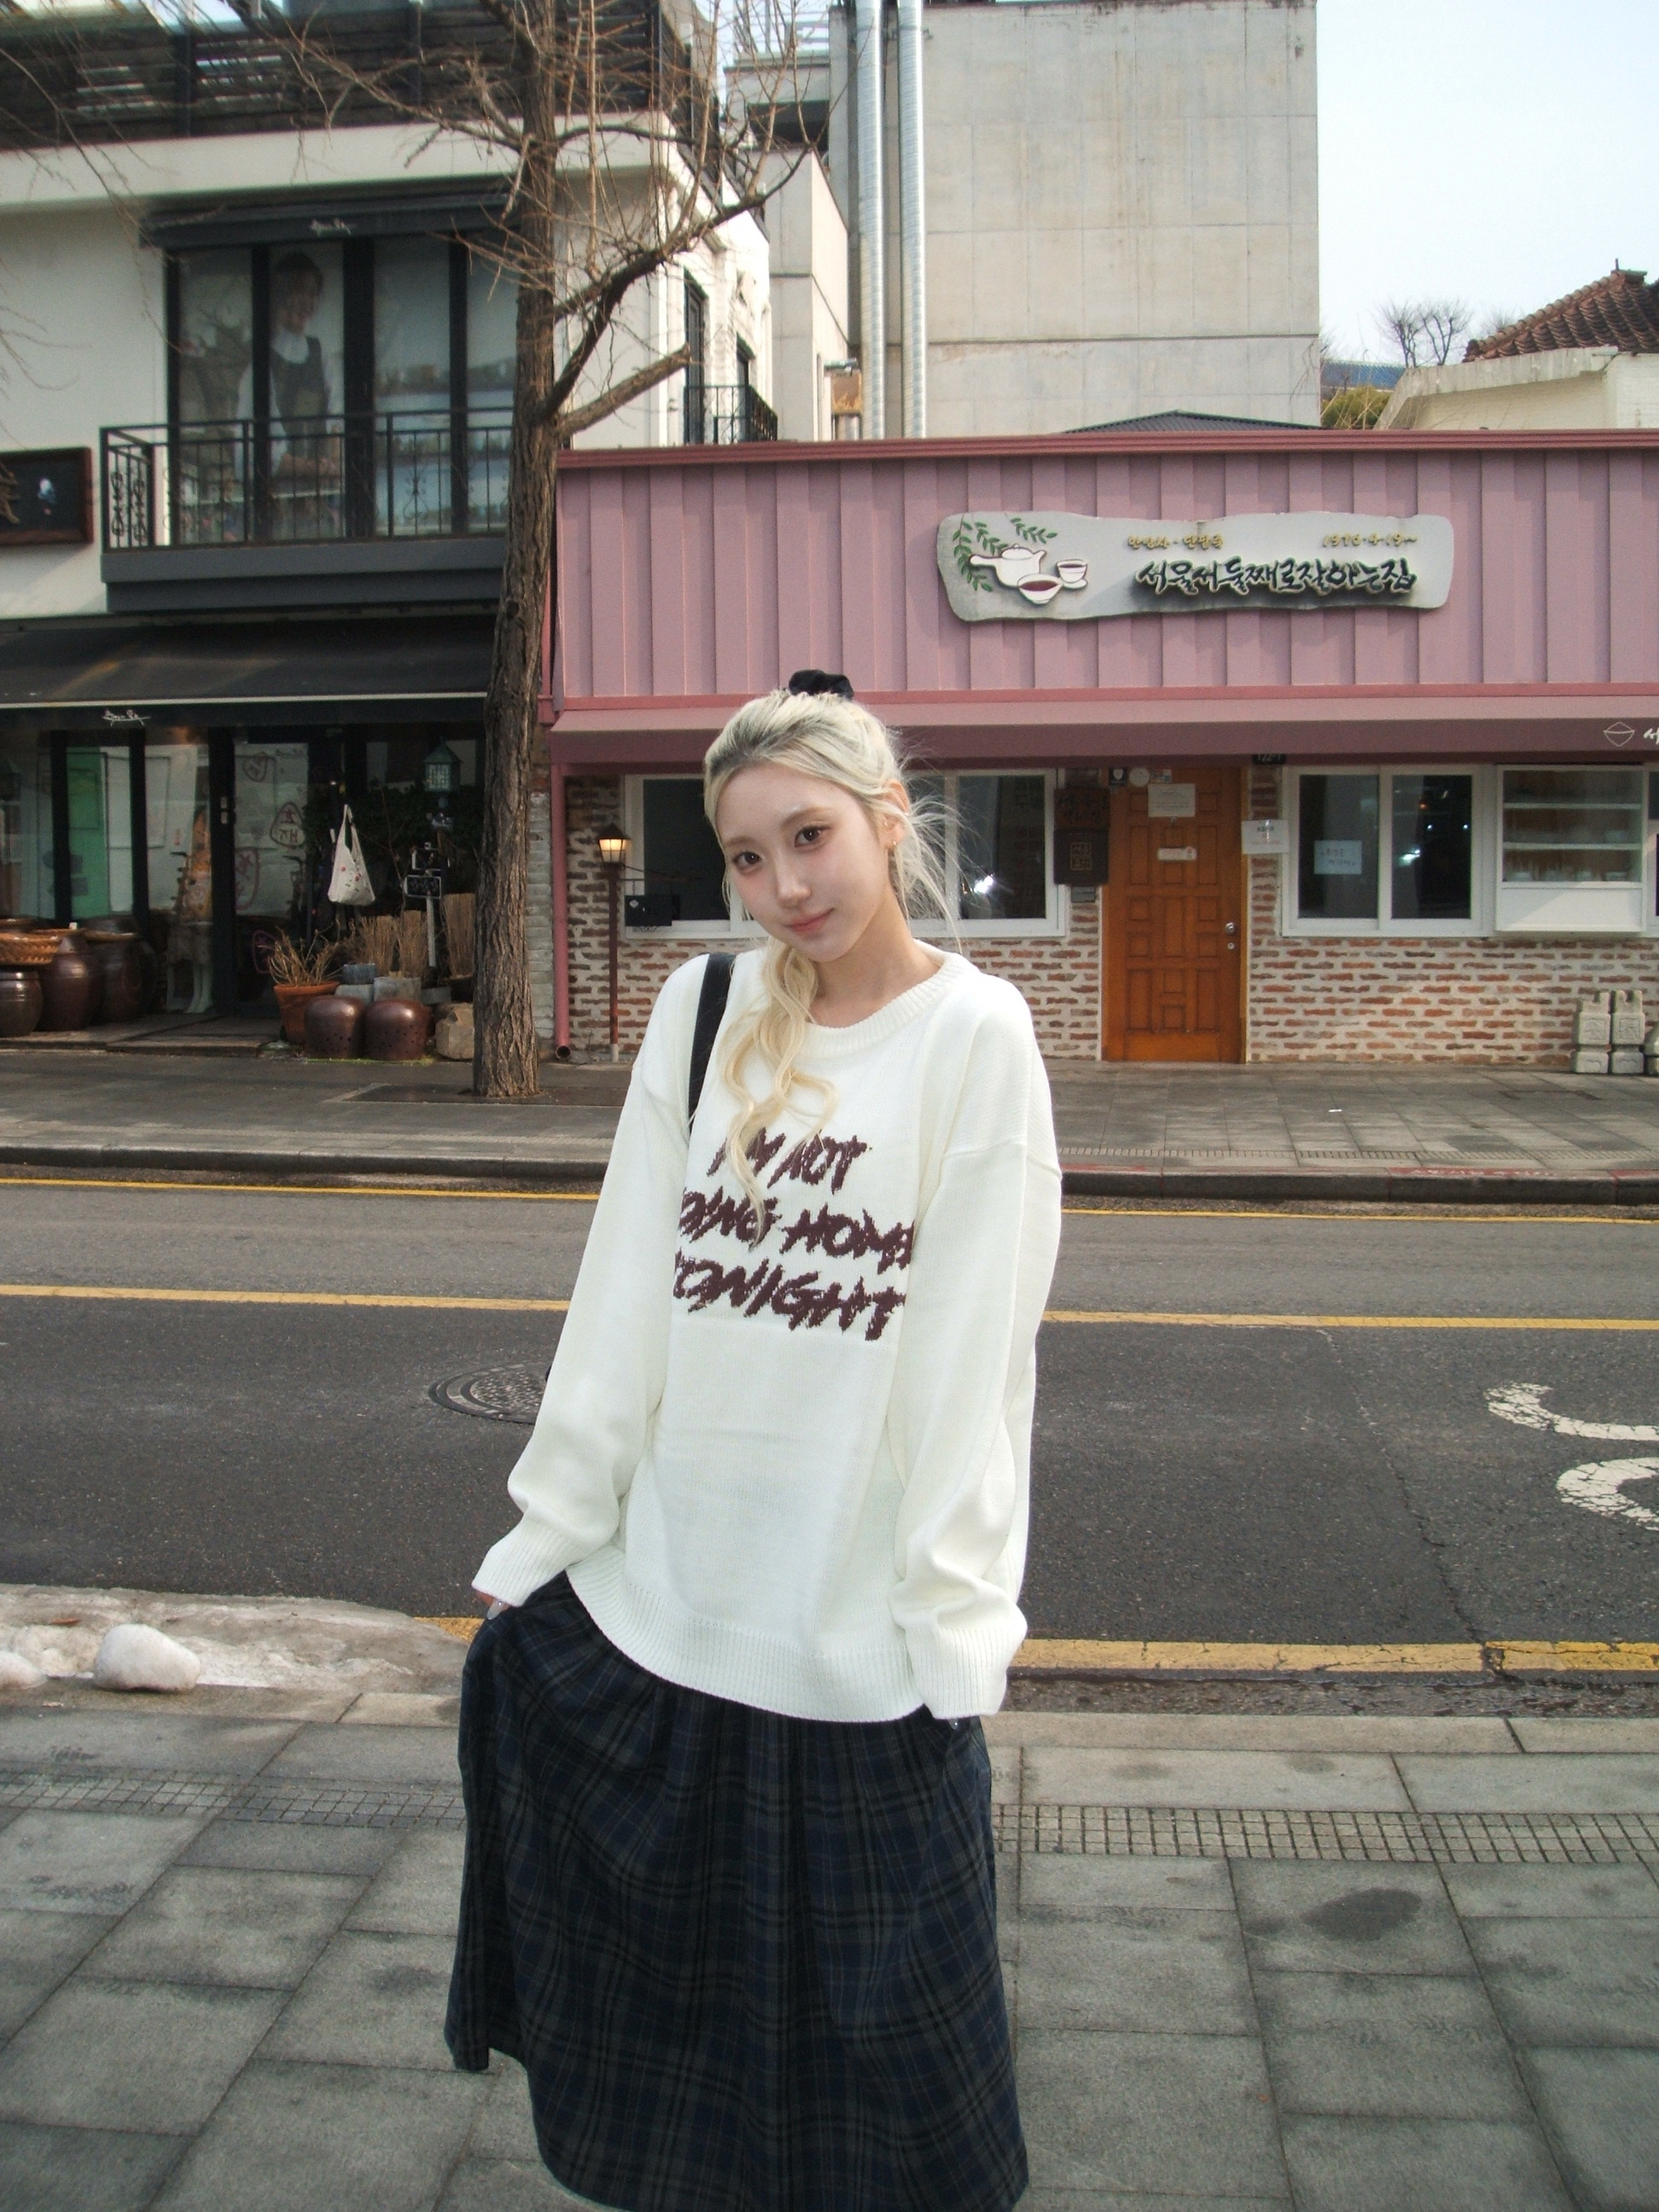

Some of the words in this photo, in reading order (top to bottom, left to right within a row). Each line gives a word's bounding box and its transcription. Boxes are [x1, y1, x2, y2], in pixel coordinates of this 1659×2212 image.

[767, 1129, 871, 1196] NOT
[678, 1185, 783, 1252] OING
[673, 1247, 906, 1341] ONIGHT
